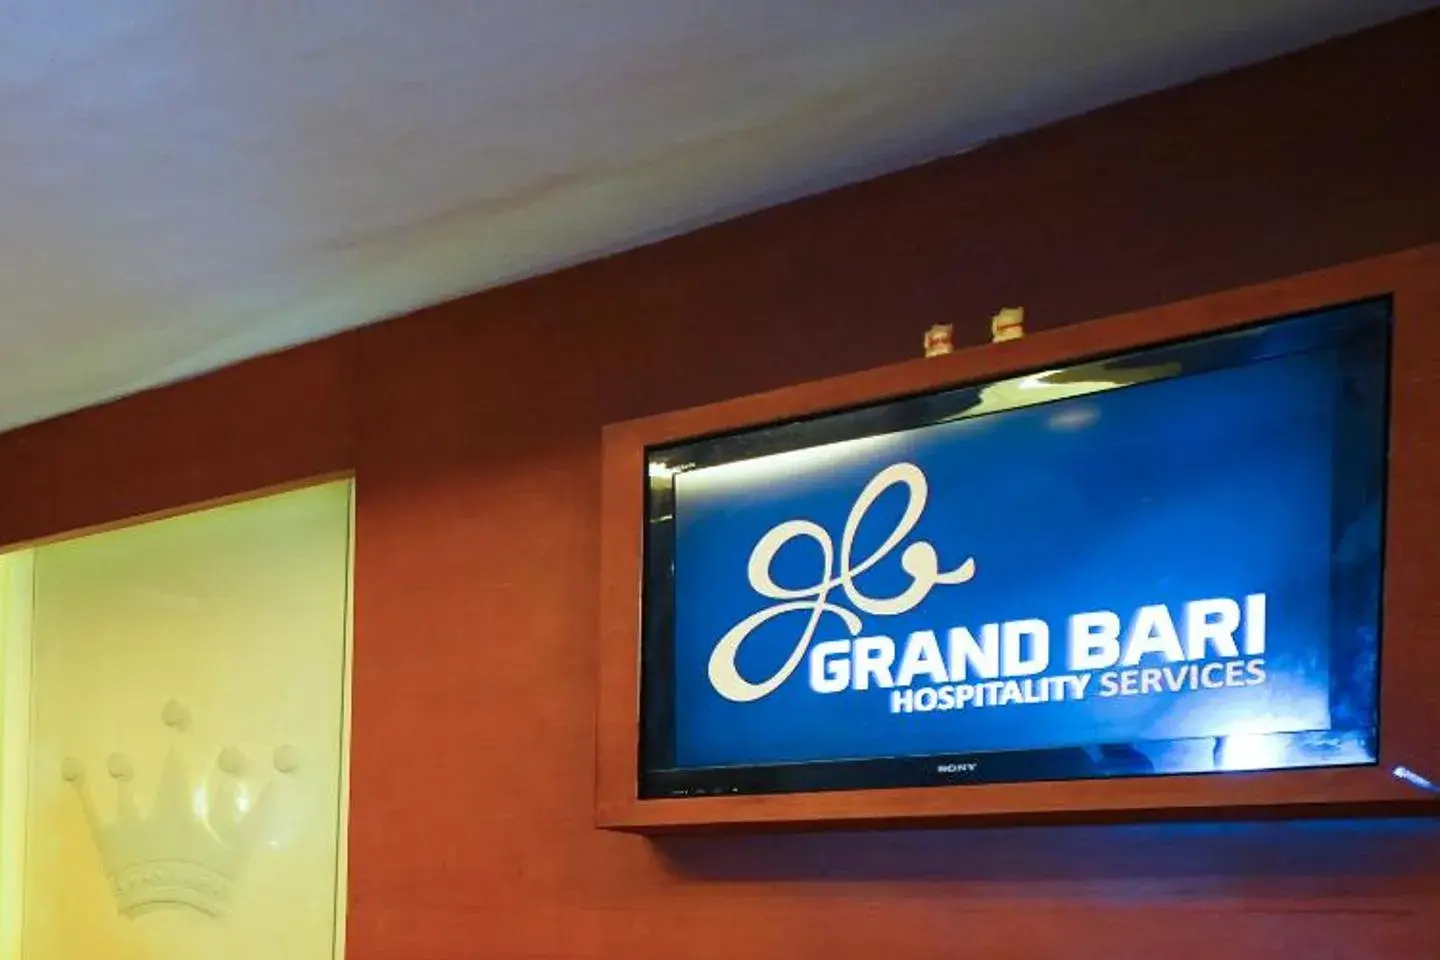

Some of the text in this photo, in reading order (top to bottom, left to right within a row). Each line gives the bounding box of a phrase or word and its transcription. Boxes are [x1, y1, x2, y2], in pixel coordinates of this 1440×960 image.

[809, 593, 1267, 694] GRAND BARI
[889, 658, 1267, 714] HOSPITALITY SERVICES
[937, 763, 977, 773] SONY
